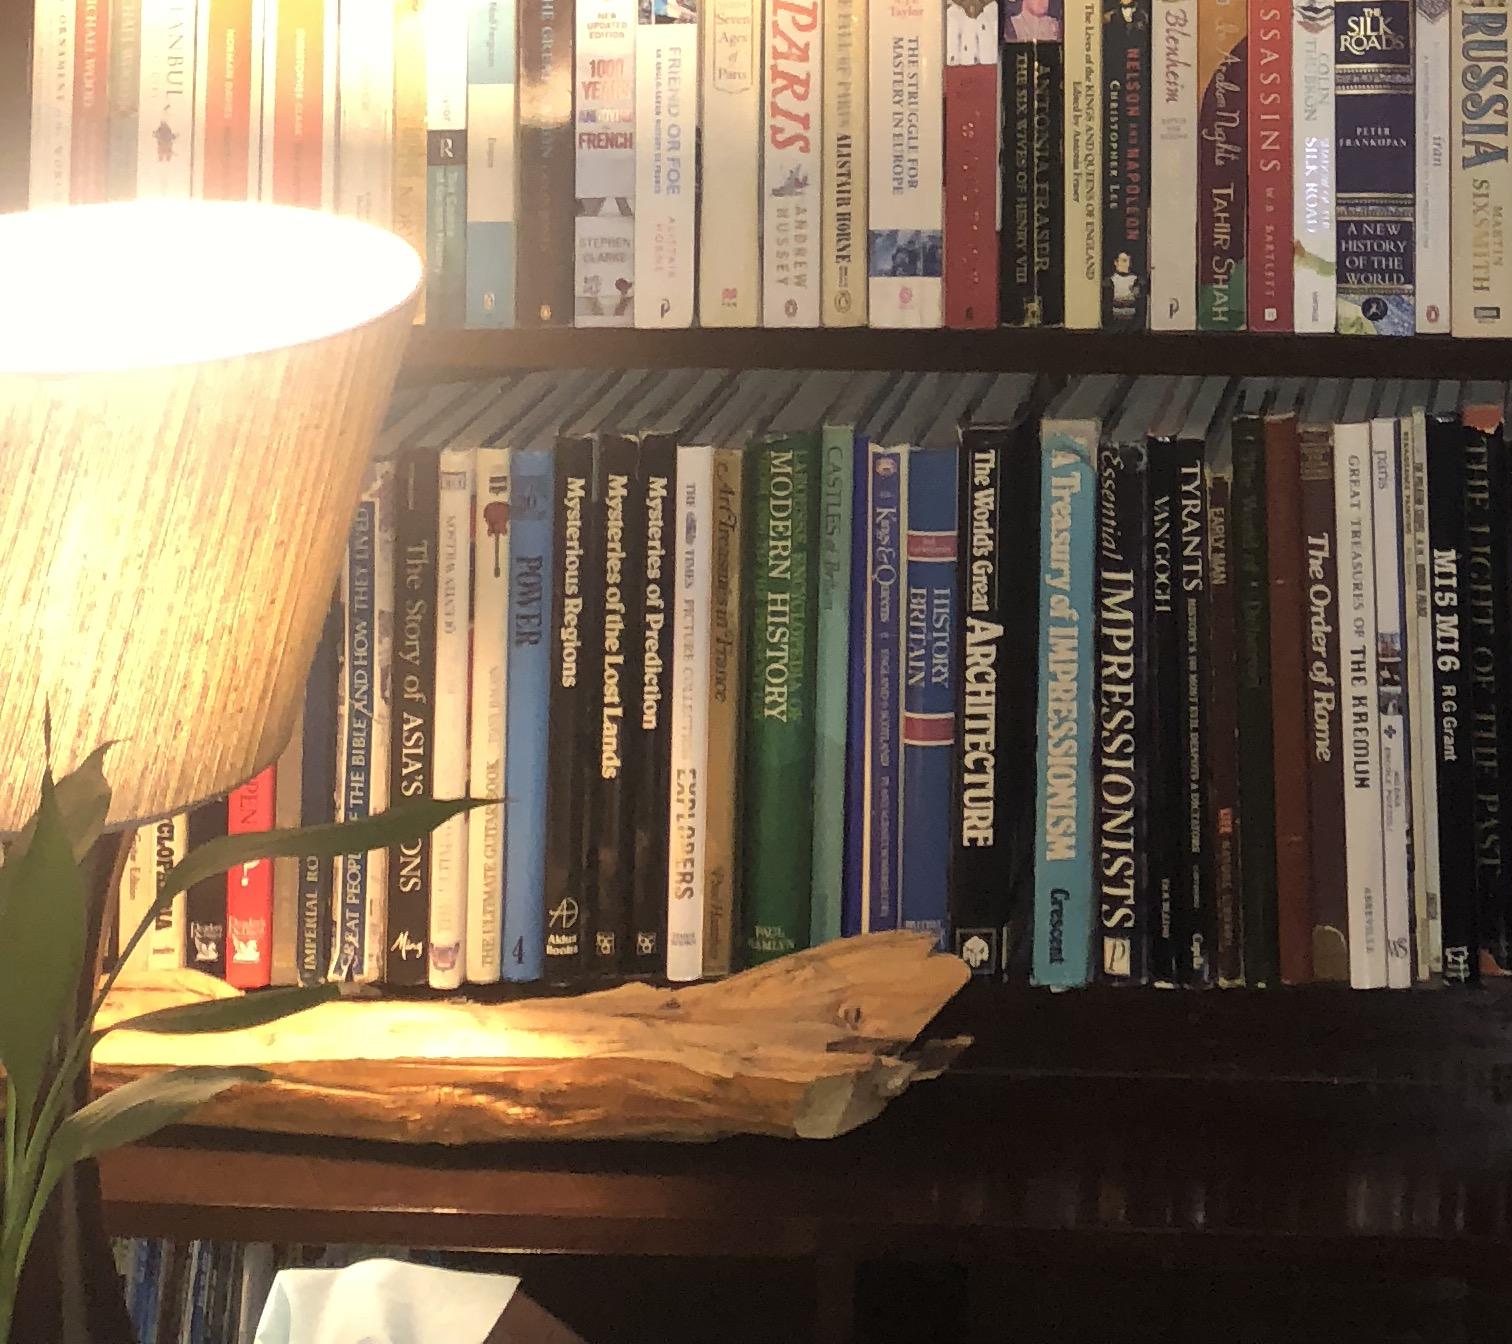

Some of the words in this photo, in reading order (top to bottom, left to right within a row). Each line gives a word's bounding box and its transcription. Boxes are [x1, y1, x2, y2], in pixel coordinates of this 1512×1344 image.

[1340, 35, 1405, 54] ROADS
[1347, 18, 1393, 37] SILK
[1364, 8, 1381, 18] THE
[1462, 11, 1508, 171] RUSSIA
[1212, 183, 1236, 251] TAHIR
[1341, 240, 1406, 255] HISTORY
[1348, 224, 1357, 235] A
[1364, 223, 1400, 236] NEW
[1213, 257, 1236, 322] SHAH
[1345, 272, 1404, 285] WORLD
[1346, 256, 1366, 270] OF
[1372, 257, 1402, 270] THE
[1052, 448, 1066, 468] A
[563, 478, 585, 593] Mysterious
[768, 451, 792, 583] MODERN
[1045, 469, 1080, 593] Treasury
[1181, 461, 1204, 591] TYRANTS
[1306, 533, 1328, 576] The
[1434, 548, 1458, 608] MI5
[516, 556, 543, 647] POWER
[1049, 594, 1067, 621] of
[1308, 580, 1330, 657] Order
[562, 595, 583, 687] Regions
[765, 592, 790, 723] HISTORY
[1311, 660, 1330, 684] of
[1436, 614, 1460, 673] MI6
[962, 617, 1004, 848] ARCHITECTURE
[1046, 624, 1079, 861] IMPRESSIONISM
[1102, 570, 1134, 928] IMPRESSIONISTS
[1312, 688, 1334, 762] Rome
